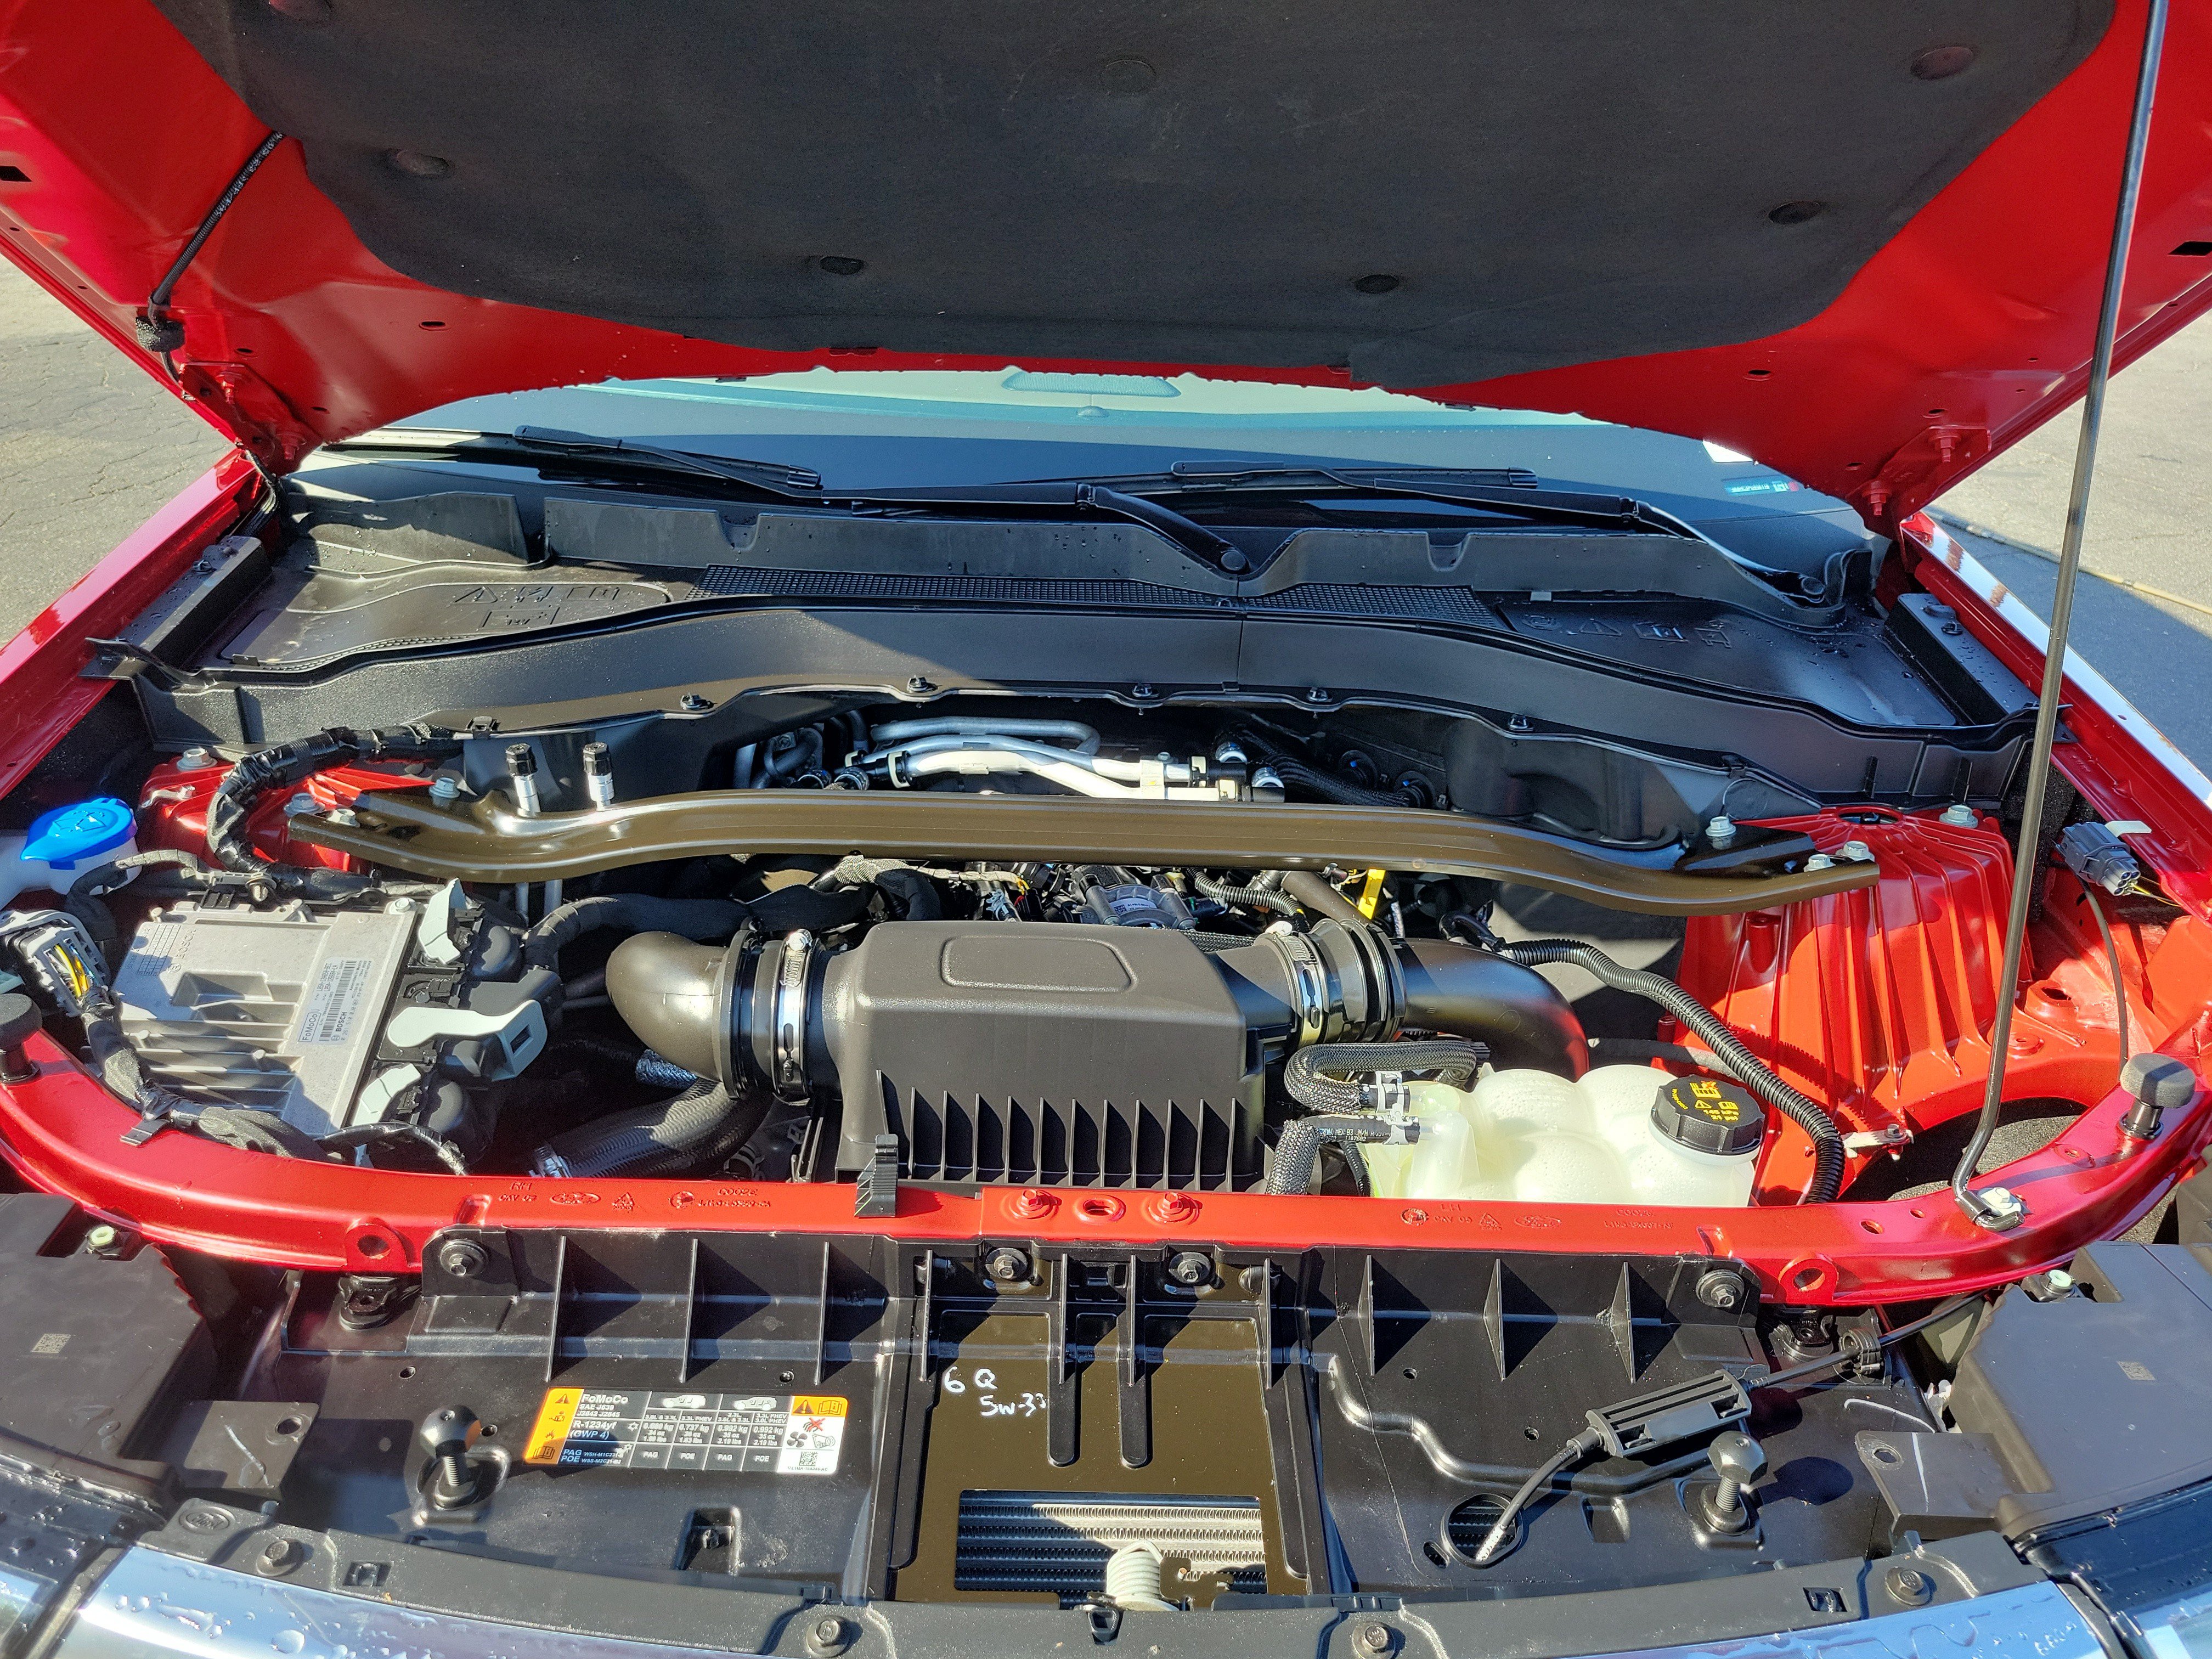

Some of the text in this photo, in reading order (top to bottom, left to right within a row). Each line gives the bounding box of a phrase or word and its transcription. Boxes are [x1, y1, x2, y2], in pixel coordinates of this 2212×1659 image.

[336, 1012, 347, 1031] BOSCH
[302, 1014, 318, 1041] FoMoCo
[944, 1365, 998, 1393] 6 Q
[581, 1394, 629, 1404] FoMoCo
[573, 1420, 618, 1431] R-1234yf
[738, 1425, 748, 1434] kg
[774, 1426, 784, 1435] kg
[569, 1430, 610, 1440] (GWP 4)
